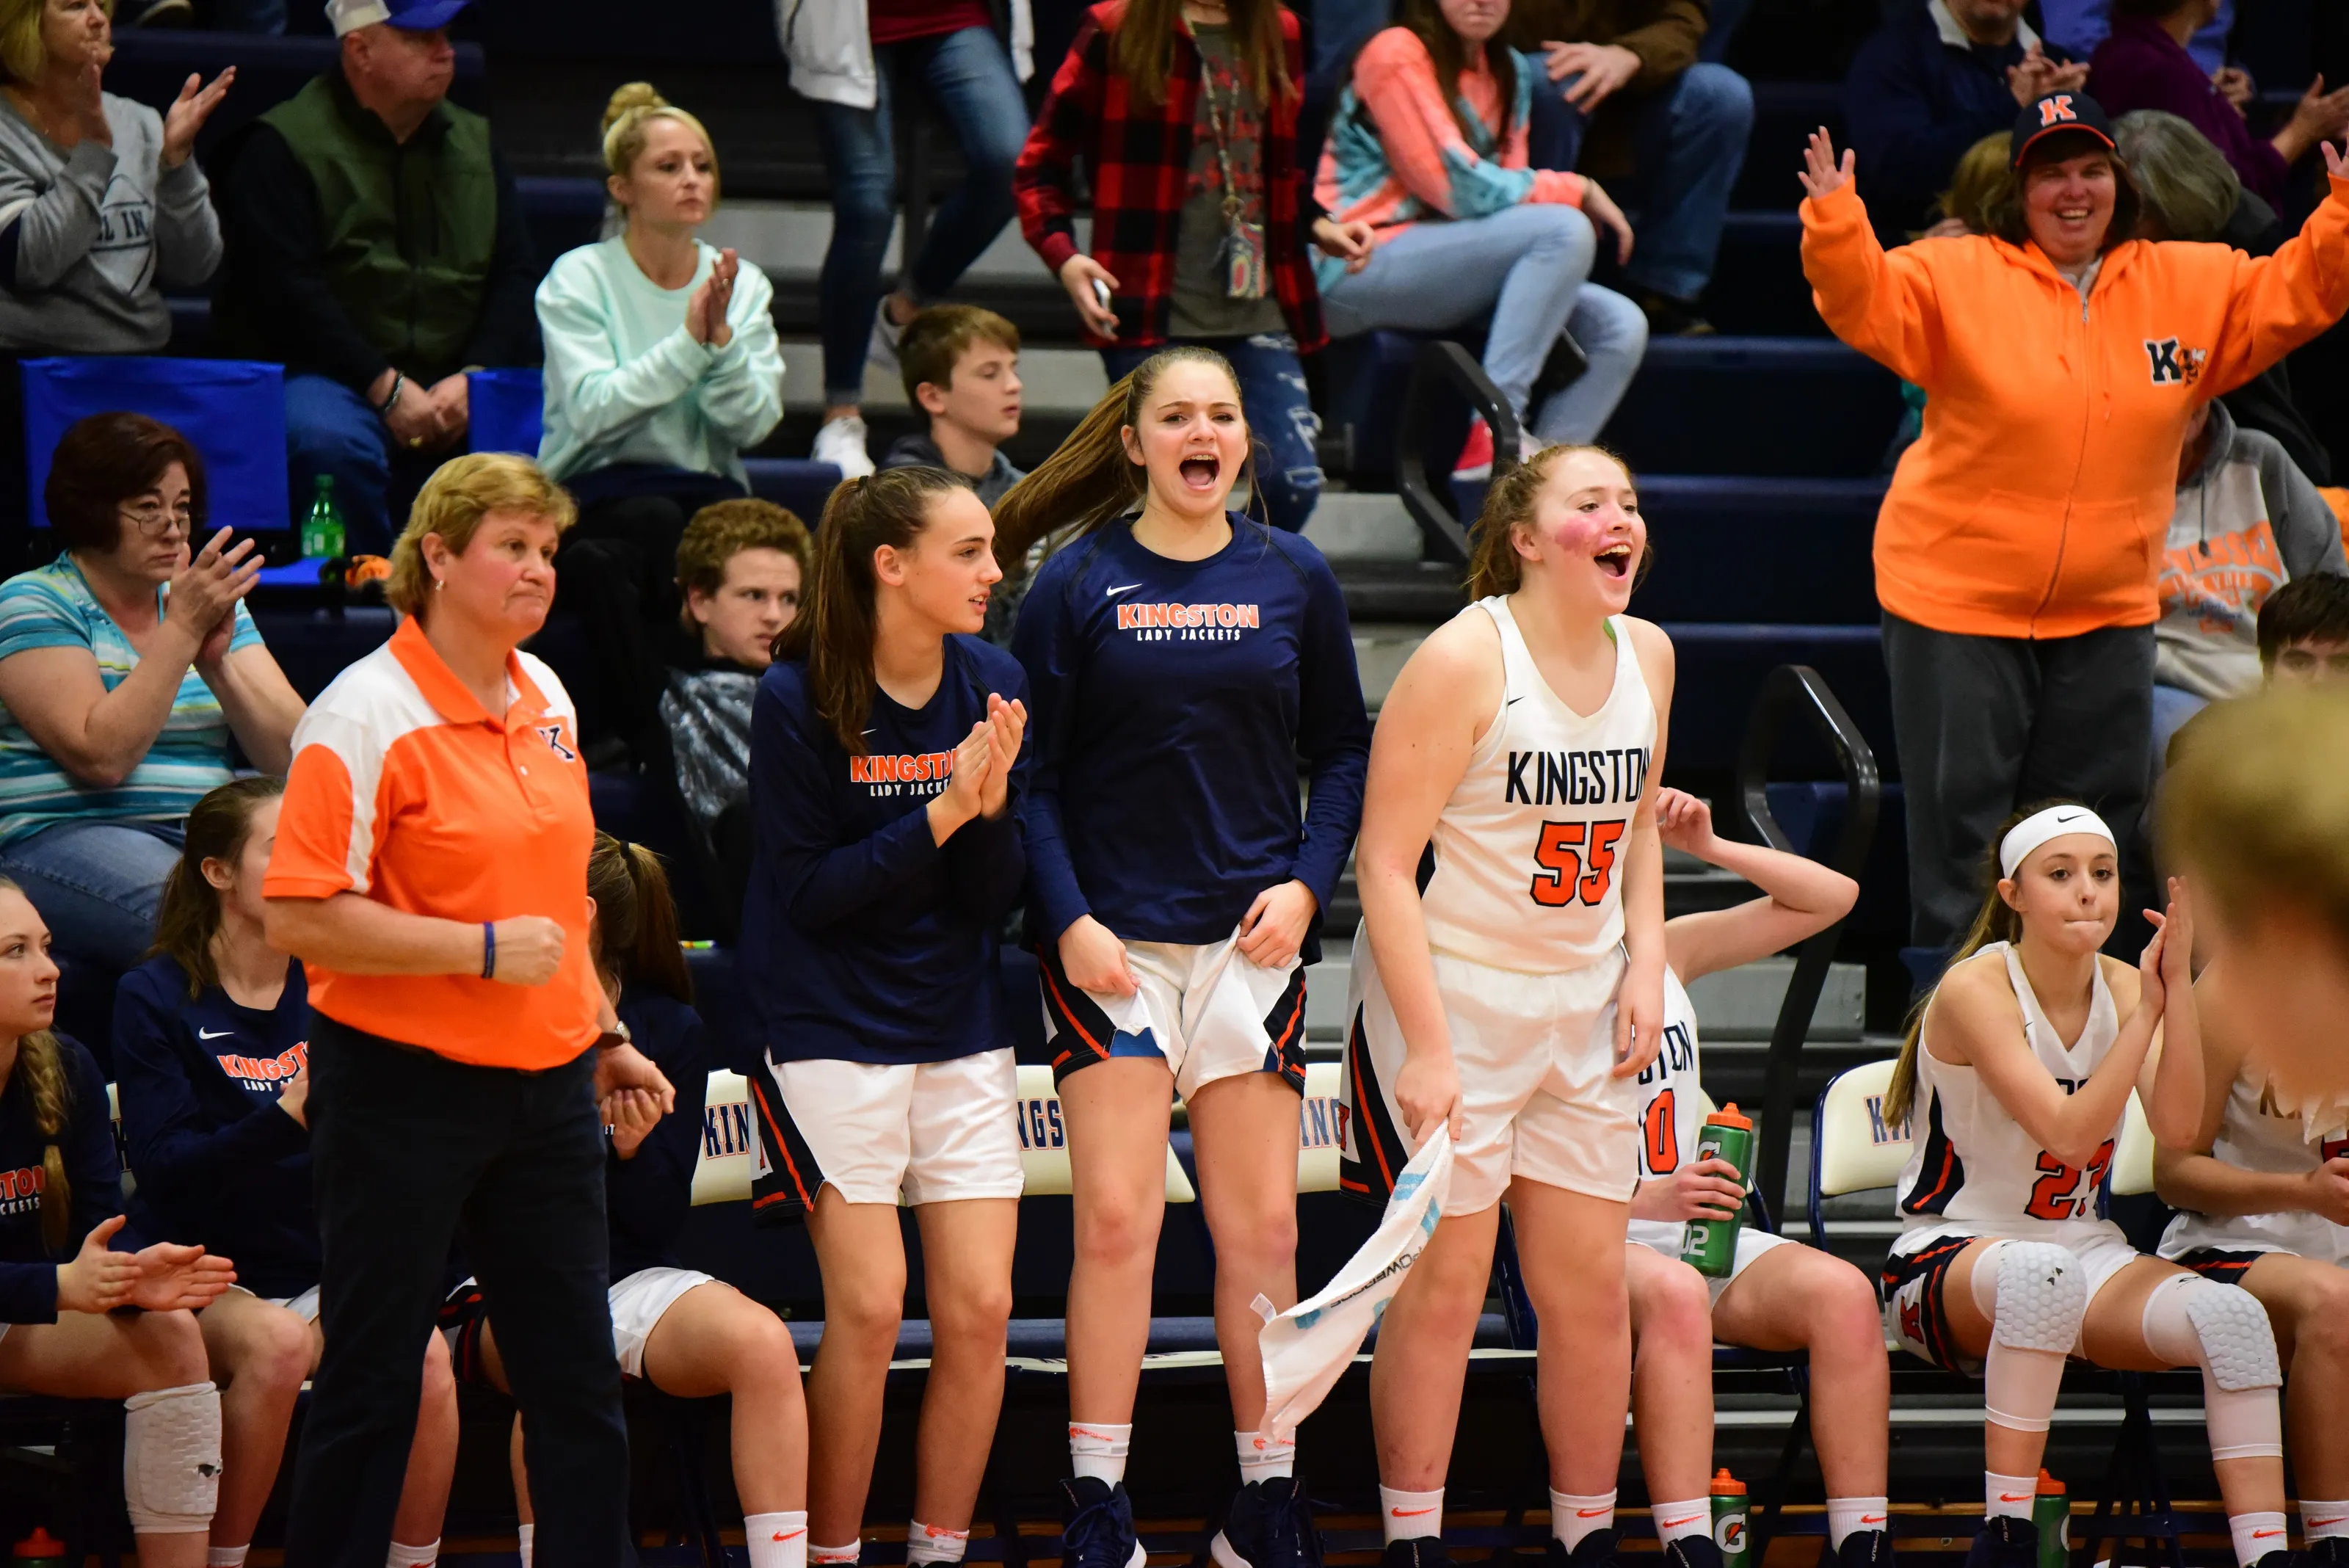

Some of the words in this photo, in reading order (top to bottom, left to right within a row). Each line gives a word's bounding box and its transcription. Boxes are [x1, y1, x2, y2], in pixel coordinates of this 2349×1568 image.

[2038, 95, 2077, 127] K
[2143, 335, 2182, 385] K
[1117, 603, 1259, 629] KINGSTON
[1137, 629, 1172, 641] LADY
[1181, 628, 1241, 641] JACKETS
[870, 784, 901, 797] LADY
[1530, 819, 1626, 907] 55
[217, 1041, 308, 1081] KINGST
[243, 1079, 272, 1092] LADY
[1638, 1088, 1679, 1175] 0
[1715, 1513, 1746, 1554] G
